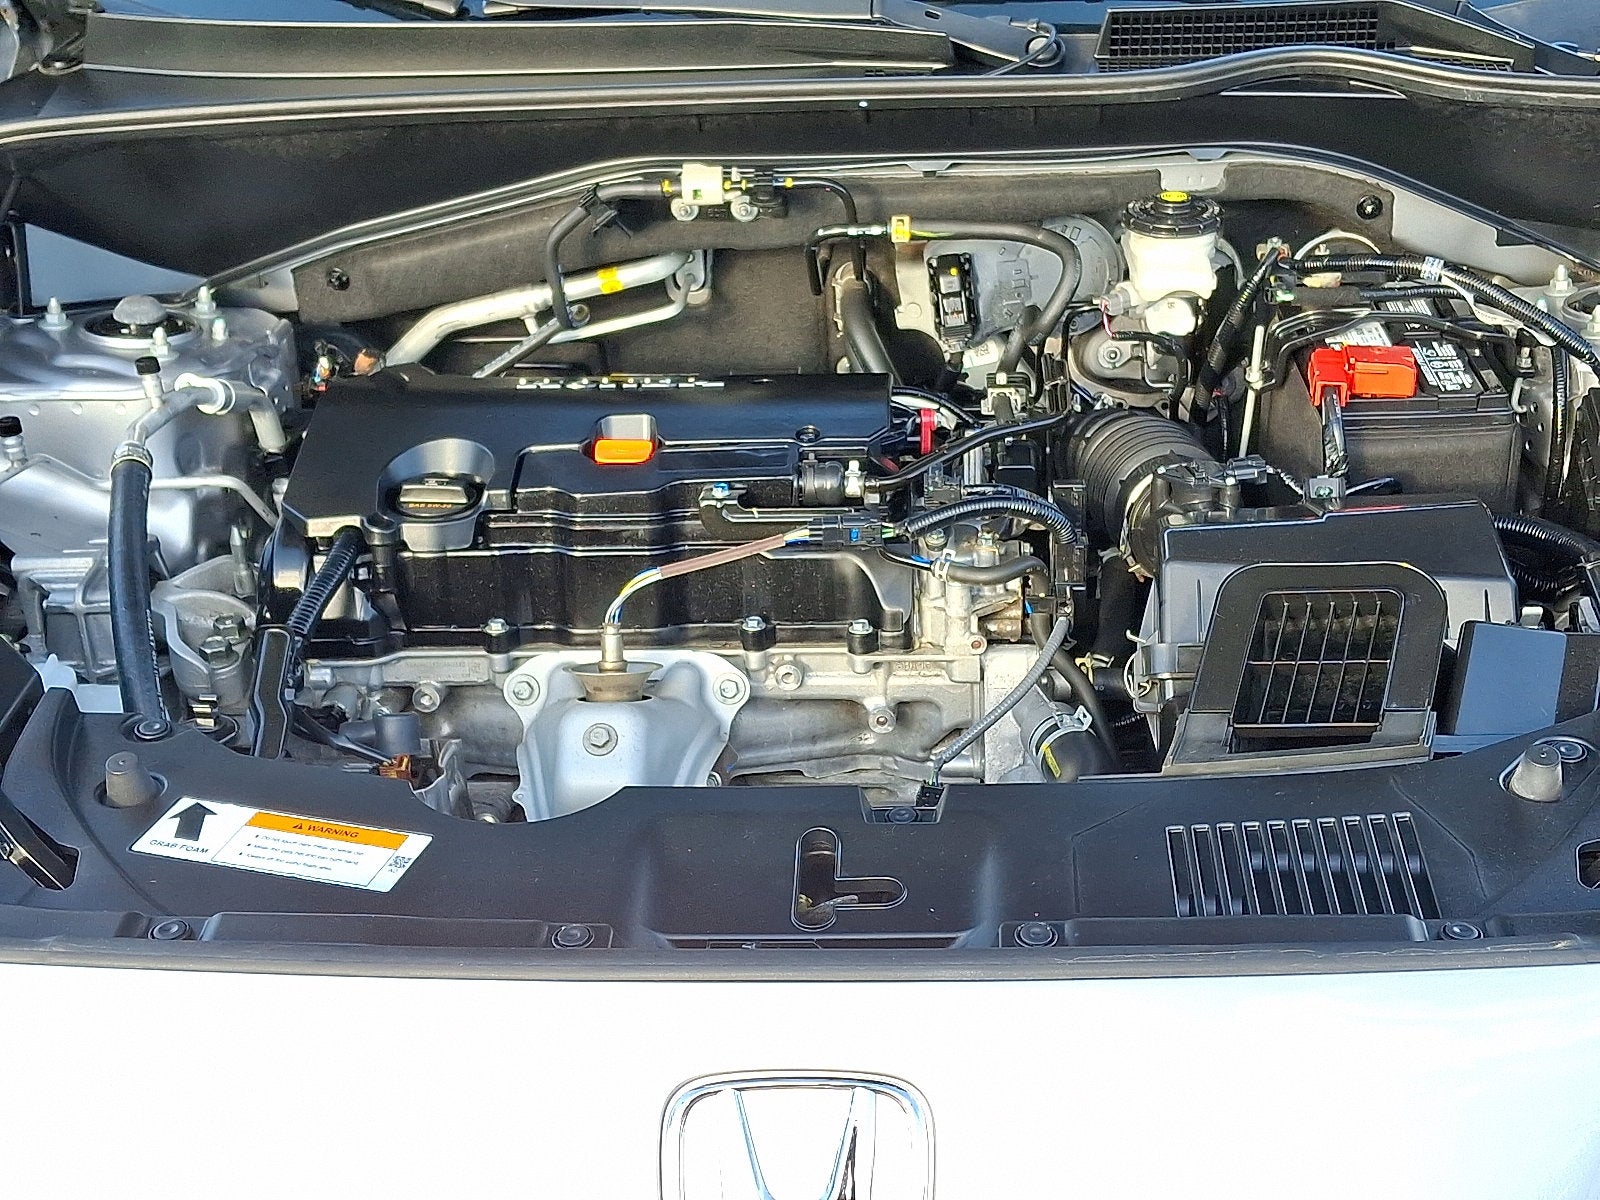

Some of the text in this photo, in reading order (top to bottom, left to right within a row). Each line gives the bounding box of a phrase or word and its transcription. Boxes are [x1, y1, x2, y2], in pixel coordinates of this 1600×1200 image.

[307, 824, 360, 838] WARNING
[149, 839, 209, 854] GRAB FOAM
